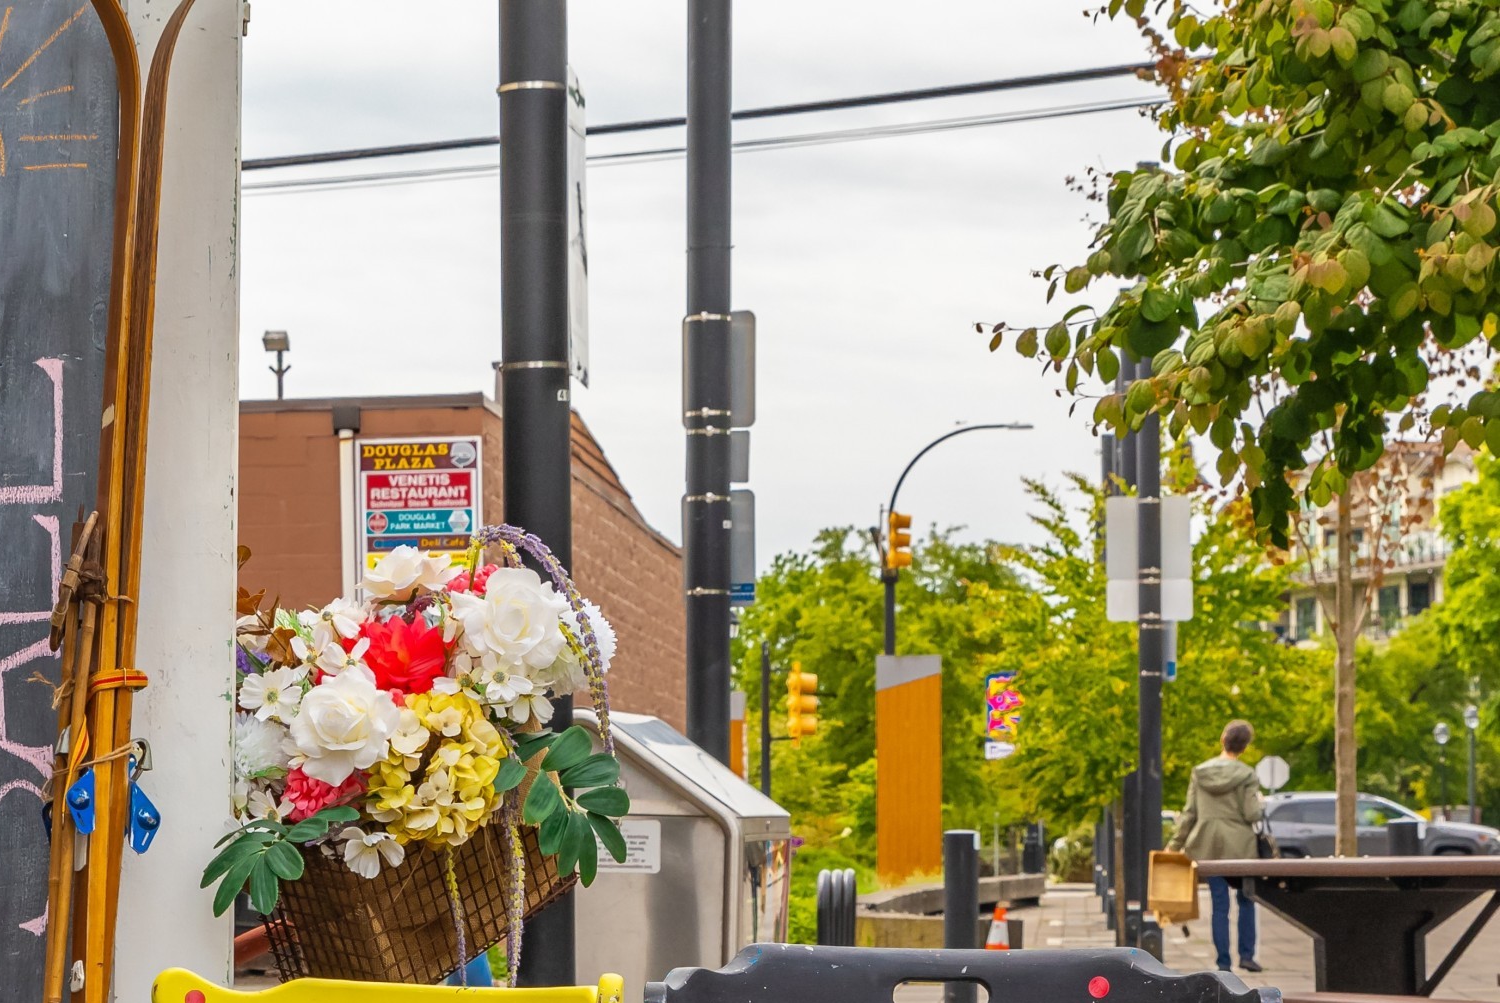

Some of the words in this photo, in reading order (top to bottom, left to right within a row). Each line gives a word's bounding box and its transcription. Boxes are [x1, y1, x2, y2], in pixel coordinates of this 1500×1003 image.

[363, 443, 449, 458] DOUGLAS
[373, 457, 436, 470] PLAZA
[388, 473, 451, 487] VENETIS
[370, 485, 468, 500] RESTAURANT
[398, 512, 437, 521] DOUGLAS
[390, 522, 411, 530] PARK
[413, 521, 445, 530] MARKET
